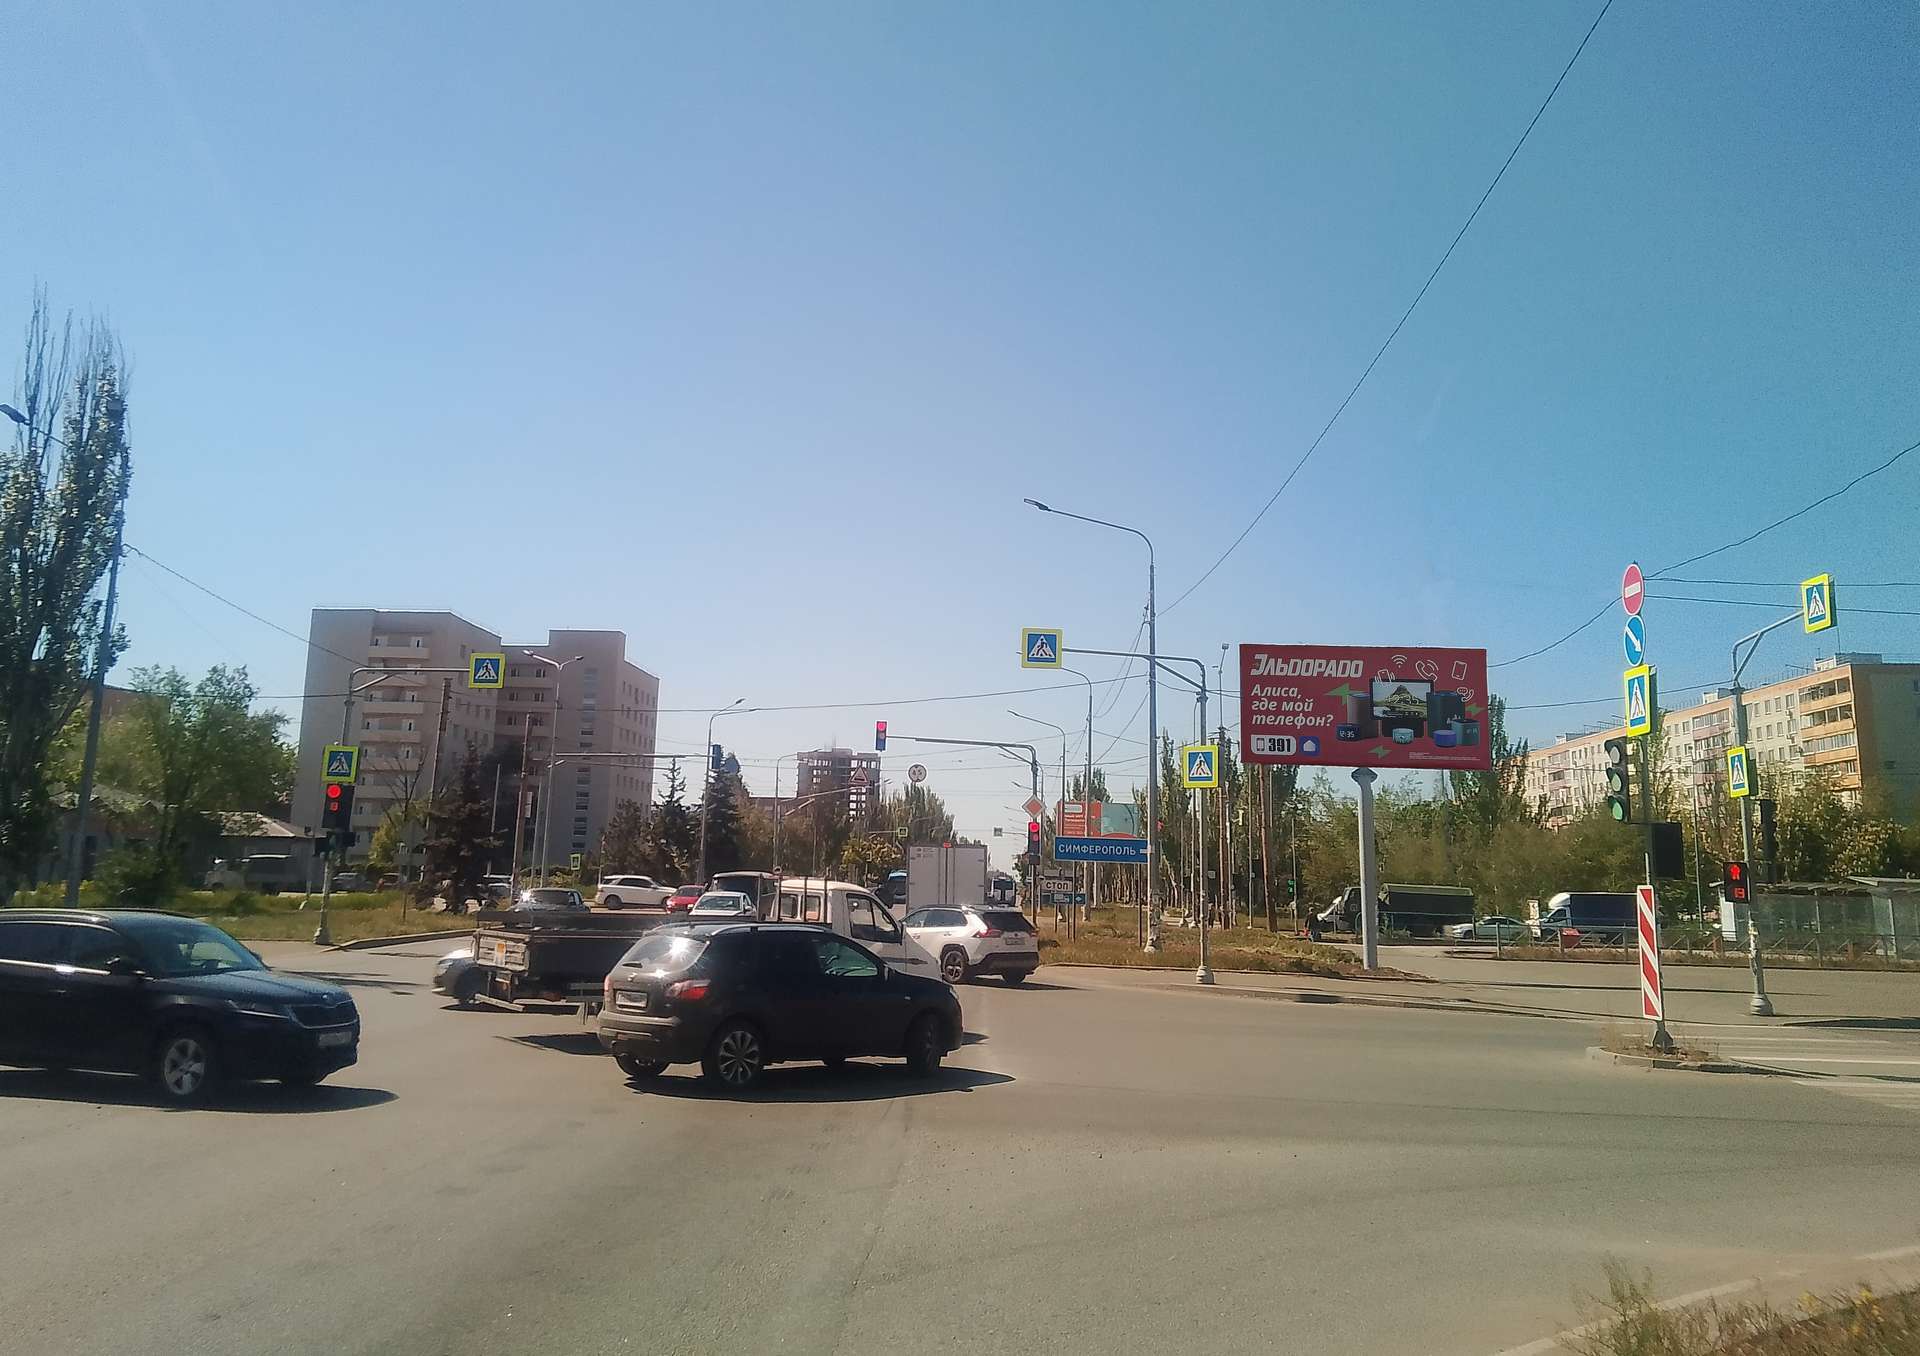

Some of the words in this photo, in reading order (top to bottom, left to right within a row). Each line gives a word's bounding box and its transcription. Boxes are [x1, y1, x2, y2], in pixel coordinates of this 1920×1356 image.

[1251, 684, 1302, 699] Алиса,
[1251, 698, 1278, 711] где
[1281, 698, 1314, 712] мой
[1252, 713, 1334, 729] телефон?
[1268, 738, 1291, 752] 391
[1058, 843, 1136, 856] СИМФЕРОПОЛЬ
[1045, 880, 1069, 890] СТОП
